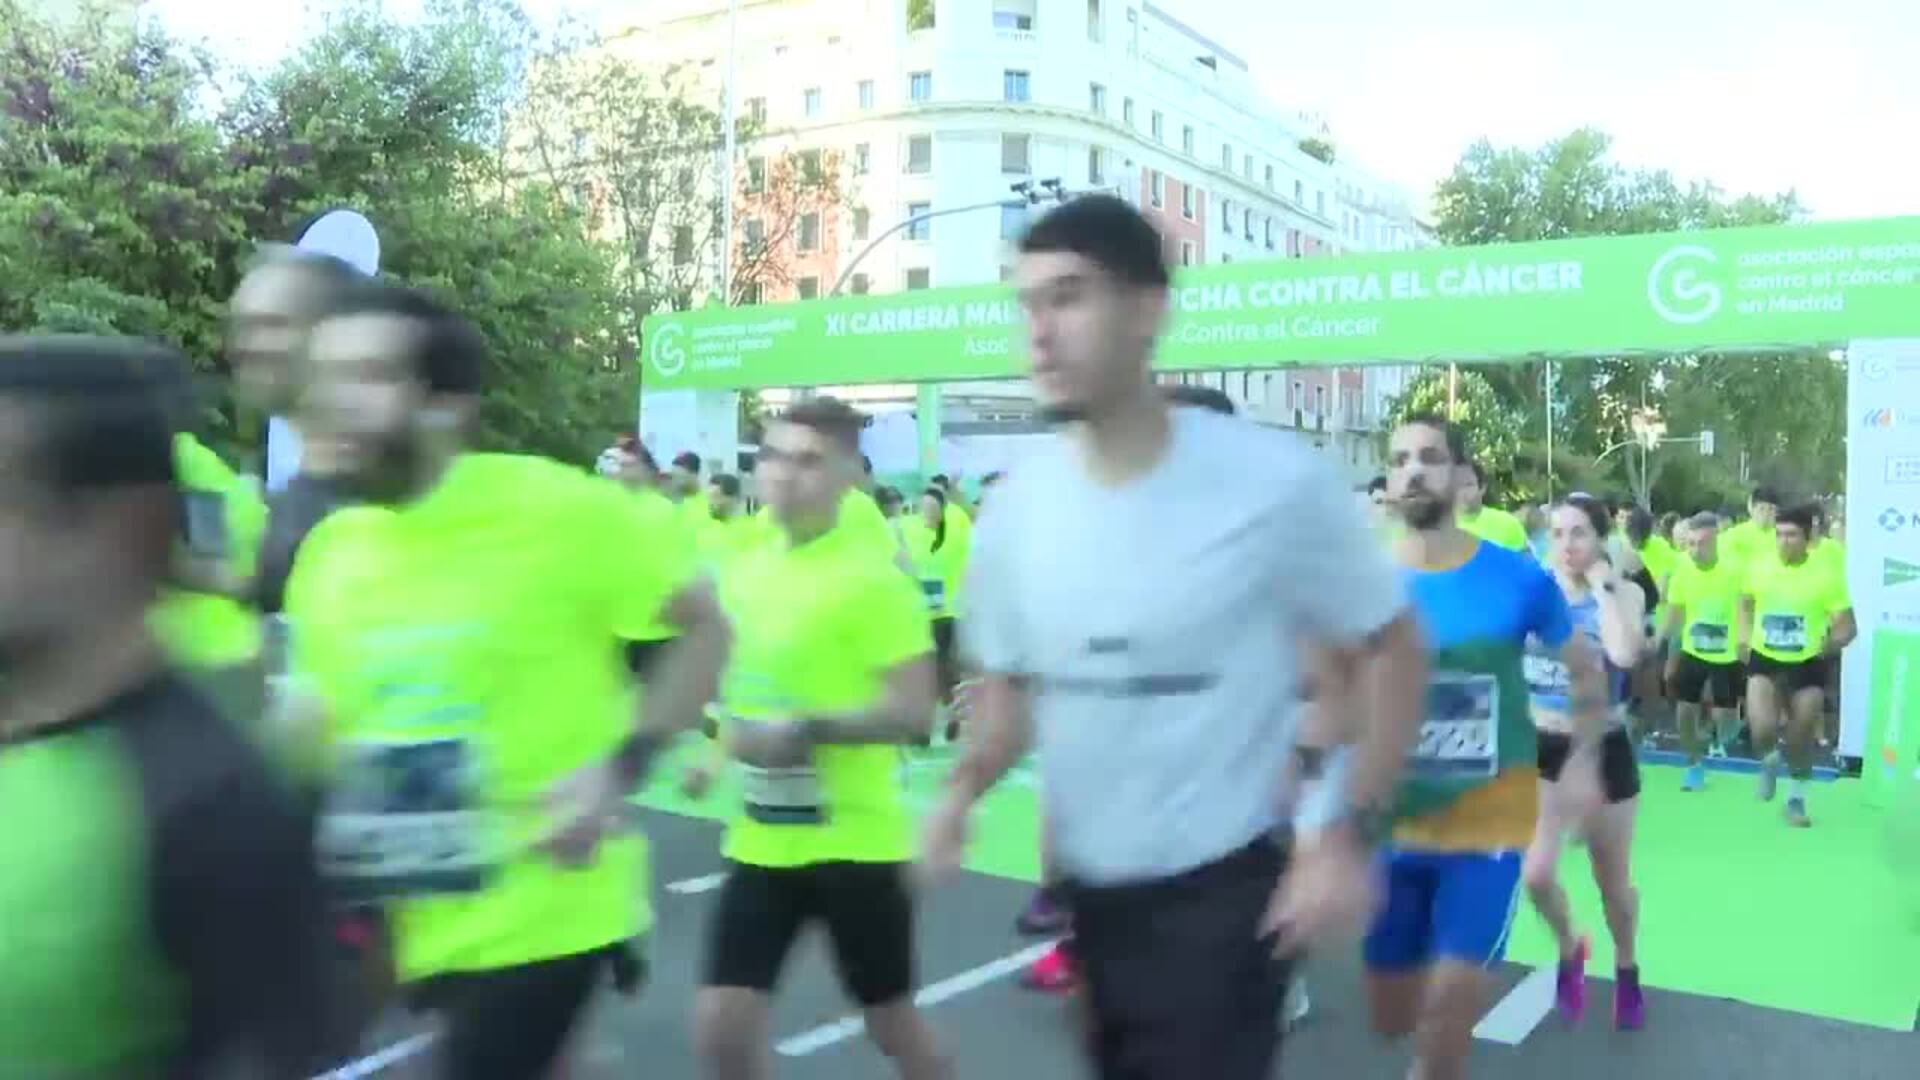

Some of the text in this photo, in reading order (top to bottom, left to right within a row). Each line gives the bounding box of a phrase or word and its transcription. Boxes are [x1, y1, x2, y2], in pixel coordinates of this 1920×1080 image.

[1737, 244, 1852, 265] asociación
[1737, 269, 1806, 289] contra
[1811, 265, 1831, 288] el
[826, 313, 845, 336] XI
[851, 304, 960, 334] CARRERA
[1248, 273, 1382, 307] CONTRA
[1390, 269, 1429, 300] EL
[1436, 259, 1584, 298] CÁNCER
[1735, 290, 1845, 313] en Madrid
[1181, 320, 1258, 344] Contra
[1265, 318, 1285, 340] el
[1292, 314, 1379, 338] Cáncer
